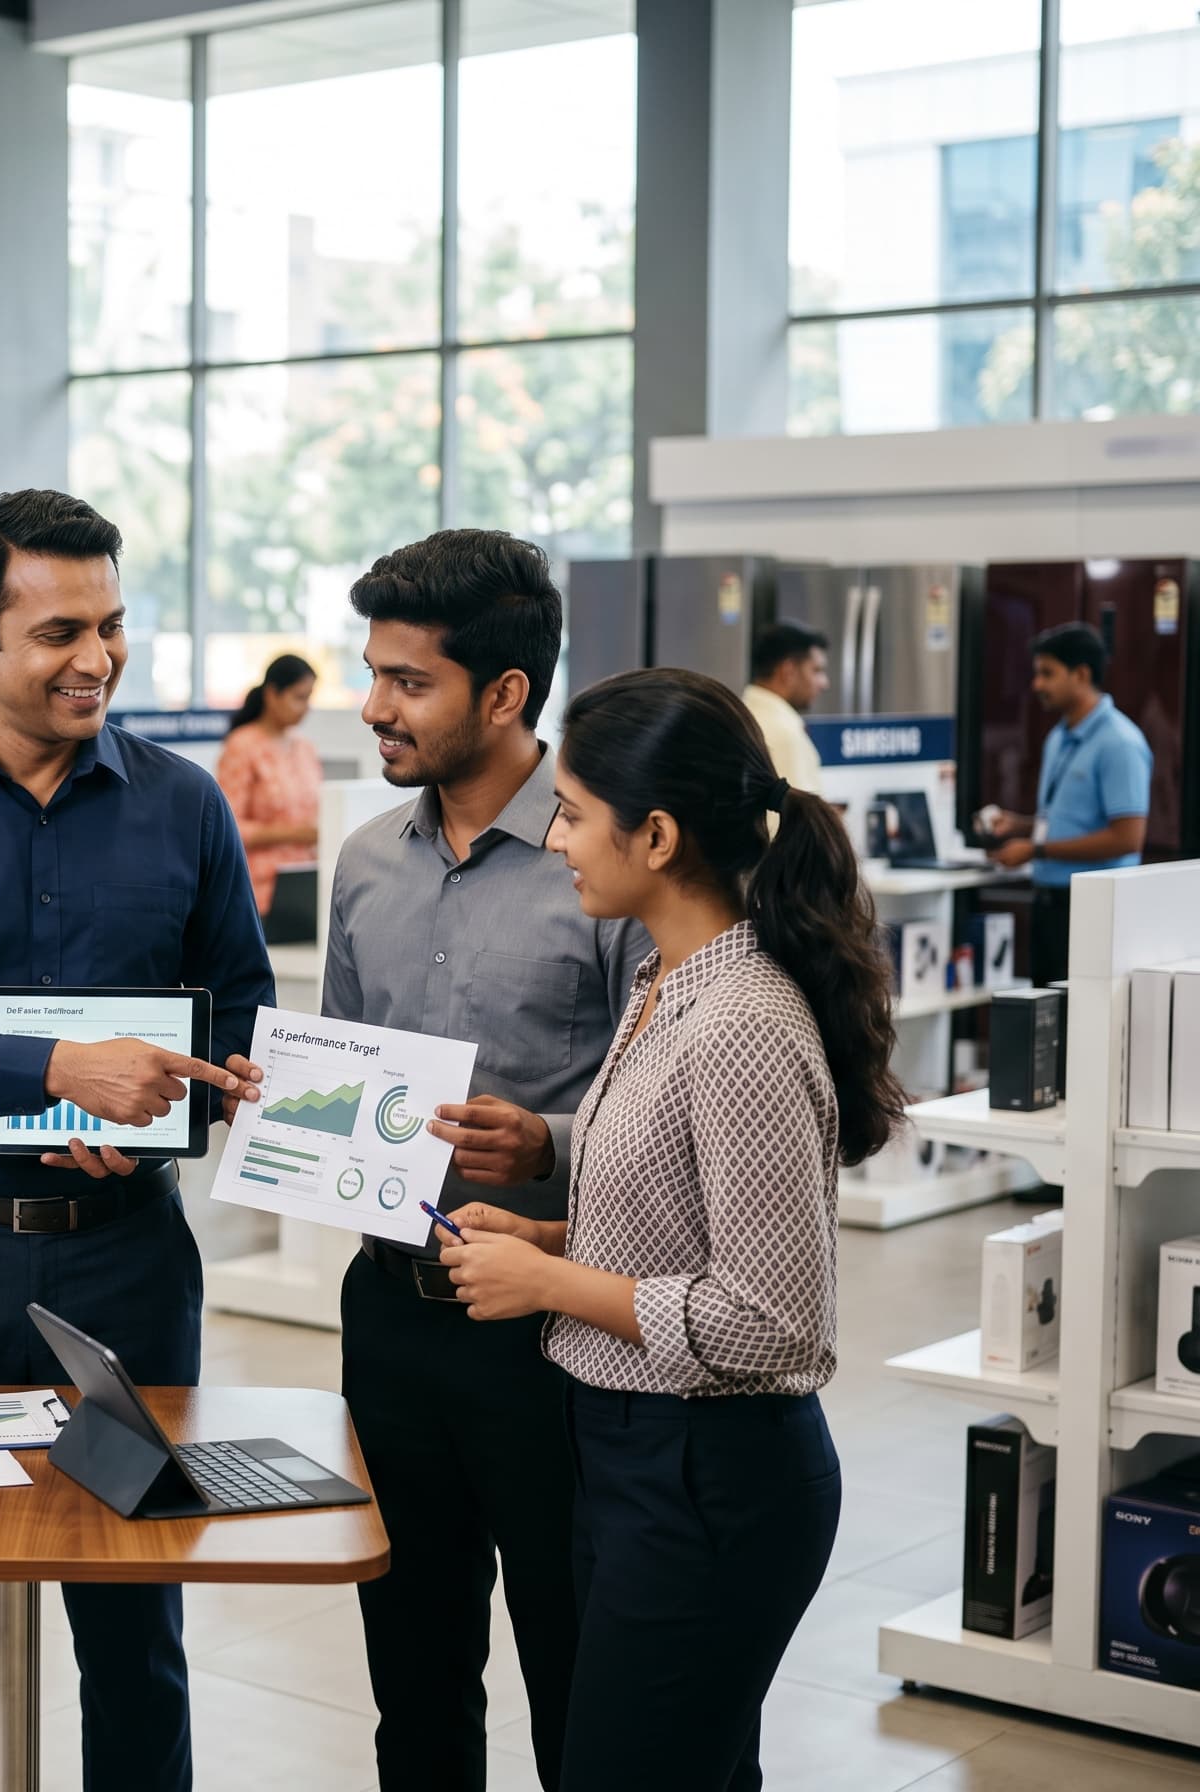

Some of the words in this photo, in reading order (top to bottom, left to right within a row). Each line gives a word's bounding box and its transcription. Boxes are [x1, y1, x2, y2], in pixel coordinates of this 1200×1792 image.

[841, 726, 921, 758] SAMSUNG
[285, 1032, 347, 1050] performance
[348, 1040, 380, 1057] Target
[1115, 1511, 1152, 1525] SONY
